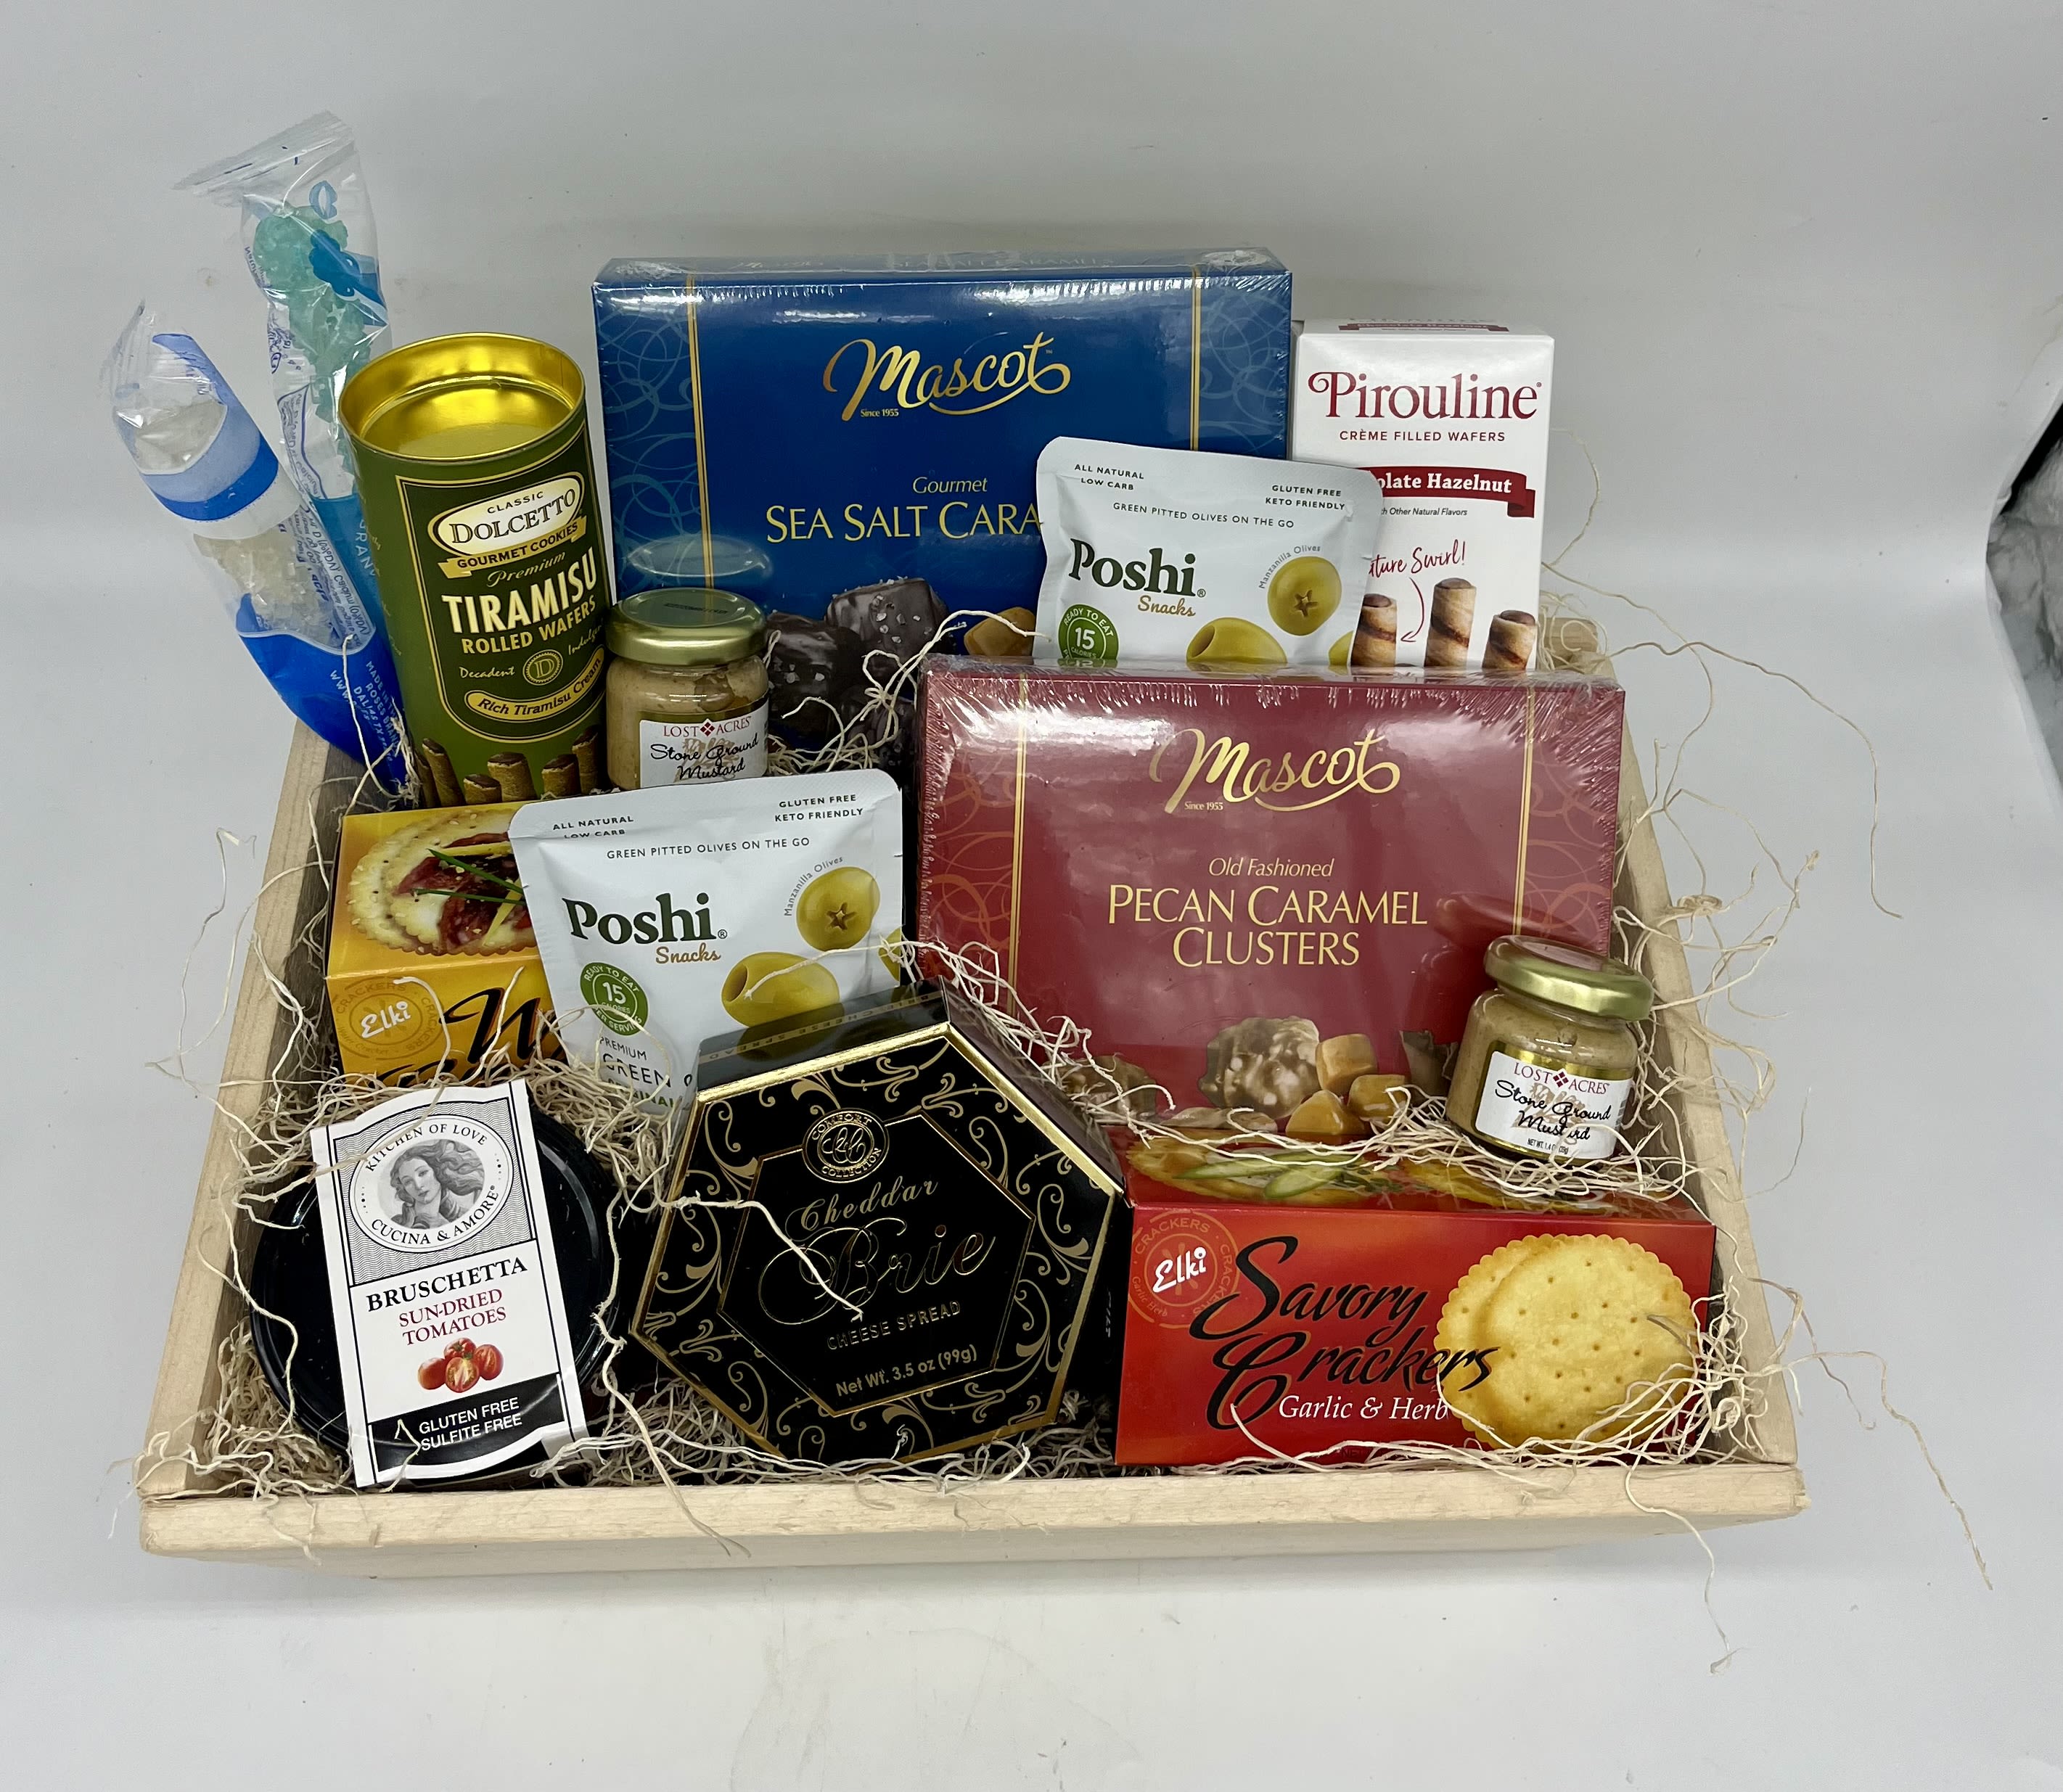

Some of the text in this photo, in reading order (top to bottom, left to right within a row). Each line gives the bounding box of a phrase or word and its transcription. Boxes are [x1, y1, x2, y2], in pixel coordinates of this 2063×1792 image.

[823, 332, 1071, 422] Mascot
[1308, 371, 1538, 419] Pirouline
[861, 408, 899, 417] Since 1955
[1340, 429, 1505, 442] CRÈME FILLED WAFERS
[912, 476, 988, 495] Gourmet
[1074, 464, 1144, 480] ALL NATURAL
[1080, 477, 1134, 491] LOW CARB
[1427, 472, 1512, 493] Hazelnut
[488, 491, 544, 514] CLASSIC
[1265, 496, 1345, 511] KETO FRIENDLY
[1271, 485, 1342, 497] GLUTEN FREE
[449, 488, 575, 543] DOLCETTO
[766, 505, 833, 544] SEA
[845, 503, 928, 542] SALT
[1113, 502, 1295, 529] GREEN PITTED OLIVES ON THE GO
[1441, 508, 1467, 517] Flavors
[457, 522, 578, 568] GOURMET COOKIES
[1411, 539, 1466, 575] Swirl!
[487, 552, 566, 588] Premium
[1068, 538, 1197, 598] Poshi
[1258, 544, 1321, 590] Manzanilla Olives
[441, 546, 596, 633] TIRAMISU
[1138, 595, 1196, 617] Snacks
[462, 632, 533, 654] ROLLED
[538, 595, 596, 641] WAFERS
[1064, 608, 1114, 636] READY TO EAT
[1075, 627, 1095, 650] 15
[366, 661, 384, 690] MADE
[459, 666, 515, 678] Decadent
[477, 658, 601, 715] Rich Tiramisu Cream
[365, 682, 387, 716] ROSES
[663, 716, 751, 738] LOST ACRES
[650, 733, 758, 768] Stone Ground
[677, 757, 746, 780] Mustard
[1149, 728, 1400, 814] Mascot
[774, 807, 864, 823] KETO FRIENDLY
[779, 794, 857, 809] GLUTEN FREE
[1184, 801, 1223, 811] Since 1955
[552, 815, 634, 831] ALL NATURAL
[564, 828, 626, 839] LOW CARB
[607, 837, 811, 860] GREEN PITTED OLIVES ON THE GO
[1208, 858, 1334, 877] Old Fashioned
[784, 856, 844, 917] Manzanilla Olives
[562, 891, 718, 945] Poshi
[1108, 884, 1428, 926] PECAN CARAMEL
[655, 942, 722, 965] Snacks
[1173, 927, 1360, 967] CLUSTERS
[584, 964, 640, 992] READY TO EAT
[602, 982, 626, 1004] 15
[336, 981, 406, 1014] CRACKERS
[360, 1000, 411, 1039] Elki
[1514, 1062, 1609, 1095] LOST ACRES
[1495, 1080, 1612, 1129] Stone Ground
[429, 1124, 448, 1134] OF
[453, 1124, 488, 1146] LOVE
[811, 1113, 872, 1140] COMFORT
[821, 1148, 882, 1177] COLLECTION
[371, 1191, 499, 1245] CUCINA & AMORE
[787, 1175, 939, 1240] Cheddar
[1135, 1217, 1210, 1254] CRACKERS
[366, 1257, 528, 1312] BRUSCHETTA
[758, 1217, 997, 1325] Brie
[1152, 1246, 1207, 1294] Elki
[1132, 1276, 1168, 1318] Garlic Herb
[1189, 1235, 1429, 1346] Savory
[399, 1288, 503, 1328] SUN-DRIED
[402, 1306, 507, 1346] TOMATOES
[827, 1301, 961, 1351] CHEESE SPREAD
[835, 1344, 978, 1397] Net Wt. 3.5 oz (99g)
[1206, 1325, 1502, 1430] Crackers
[419, 1397, 520, 1434] GLUTEN FREE
[1279, 1395, 1449, 1420] Garlic & Herb
[421, 1413, 522, 1451] SULFITE FREE
